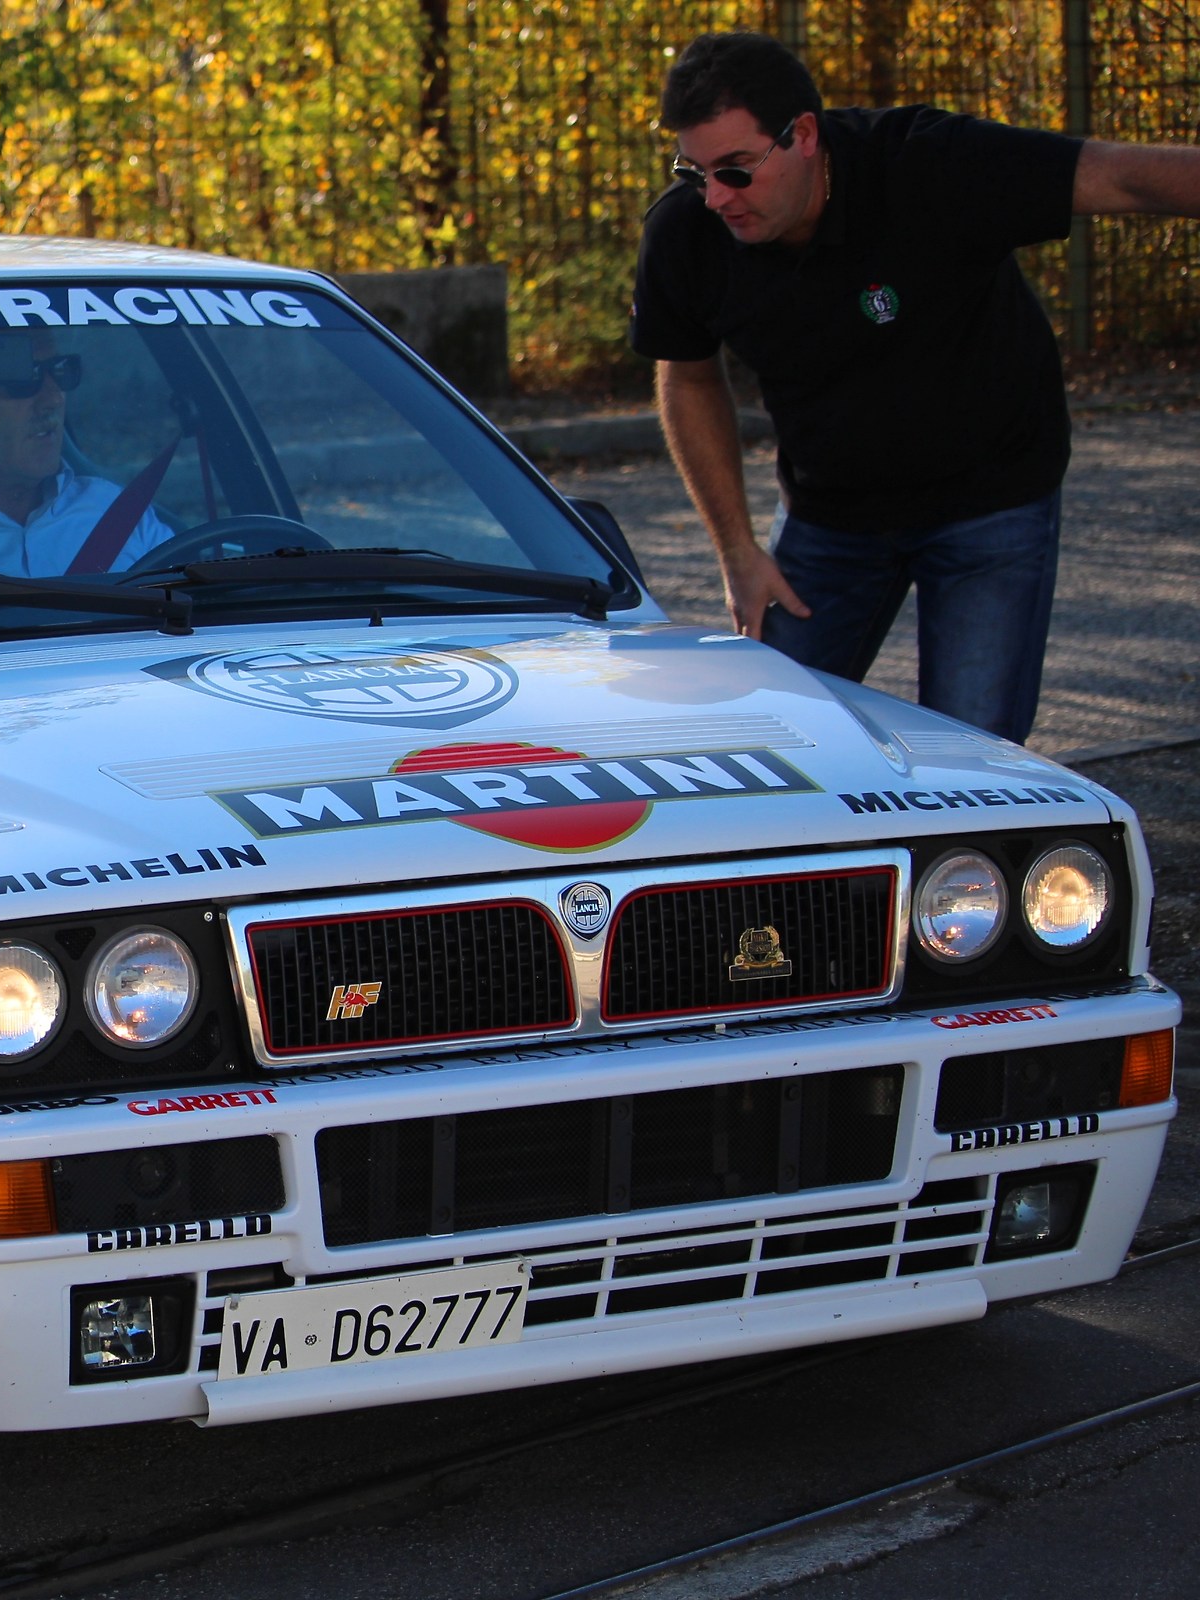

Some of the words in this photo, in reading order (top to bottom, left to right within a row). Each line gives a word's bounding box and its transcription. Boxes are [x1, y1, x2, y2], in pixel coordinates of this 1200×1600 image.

[267, 664, 437, 686] LANCIA
[243, 753, 790, 829] MARTINI
[837, 787, 1085, 814] MICHELIN
[575, 902, 599, 914] LANCIA
[326, 981, 382, 1021] HF
[930, 1004, 1058, 1030] GARRETT
[127, 1089, 277, 1116] GARRETT
[951, 1113, 1099, 1152] CARELLO
[87, 1214, 272, 1252] CARELLO
[232, 1318, 288, 1374] VA
[330, 1285, 523, 1362] D62777
